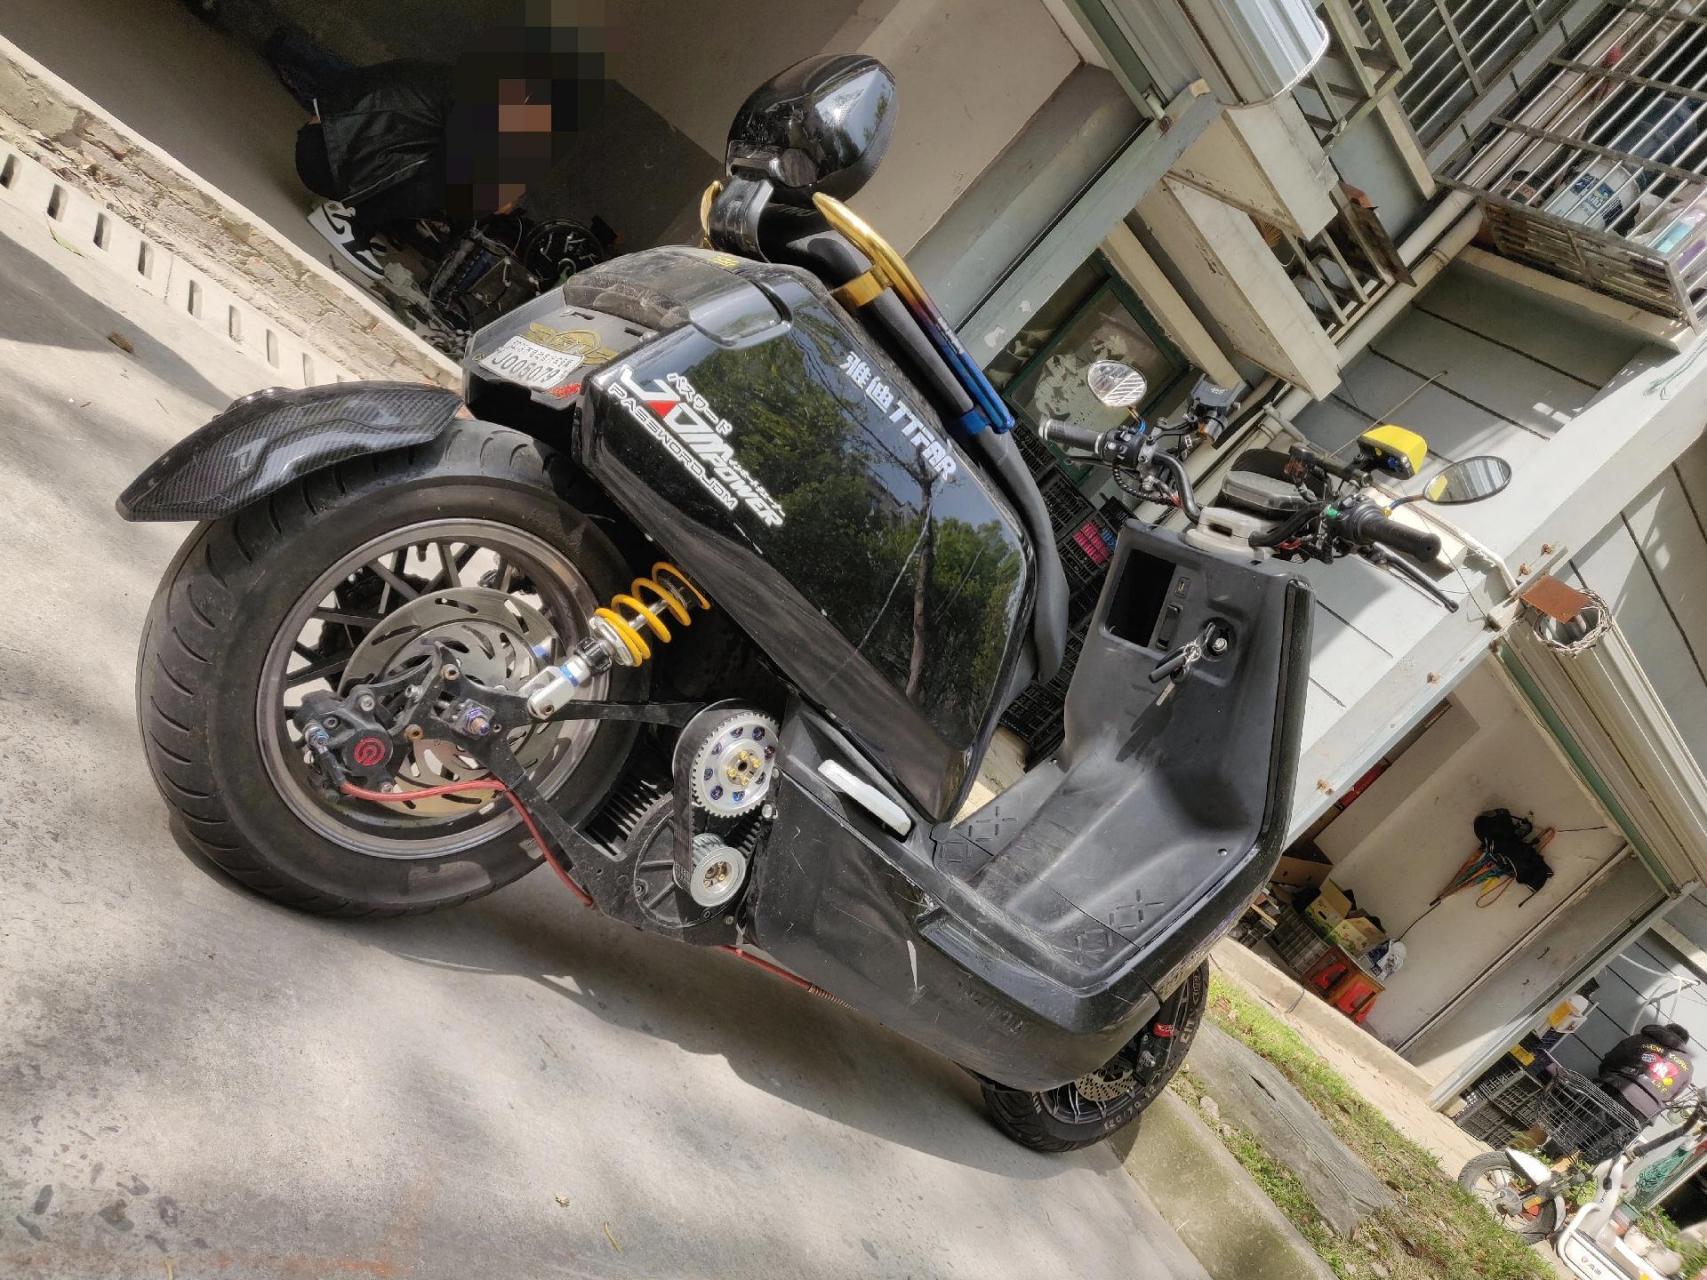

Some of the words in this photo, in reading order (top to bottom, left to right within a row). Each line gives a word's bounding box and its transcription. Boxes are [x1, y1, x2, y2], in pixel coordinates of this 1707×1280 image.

[667, 373, 733, 436] パスワード
[700, 456, 784, 527] POWER
